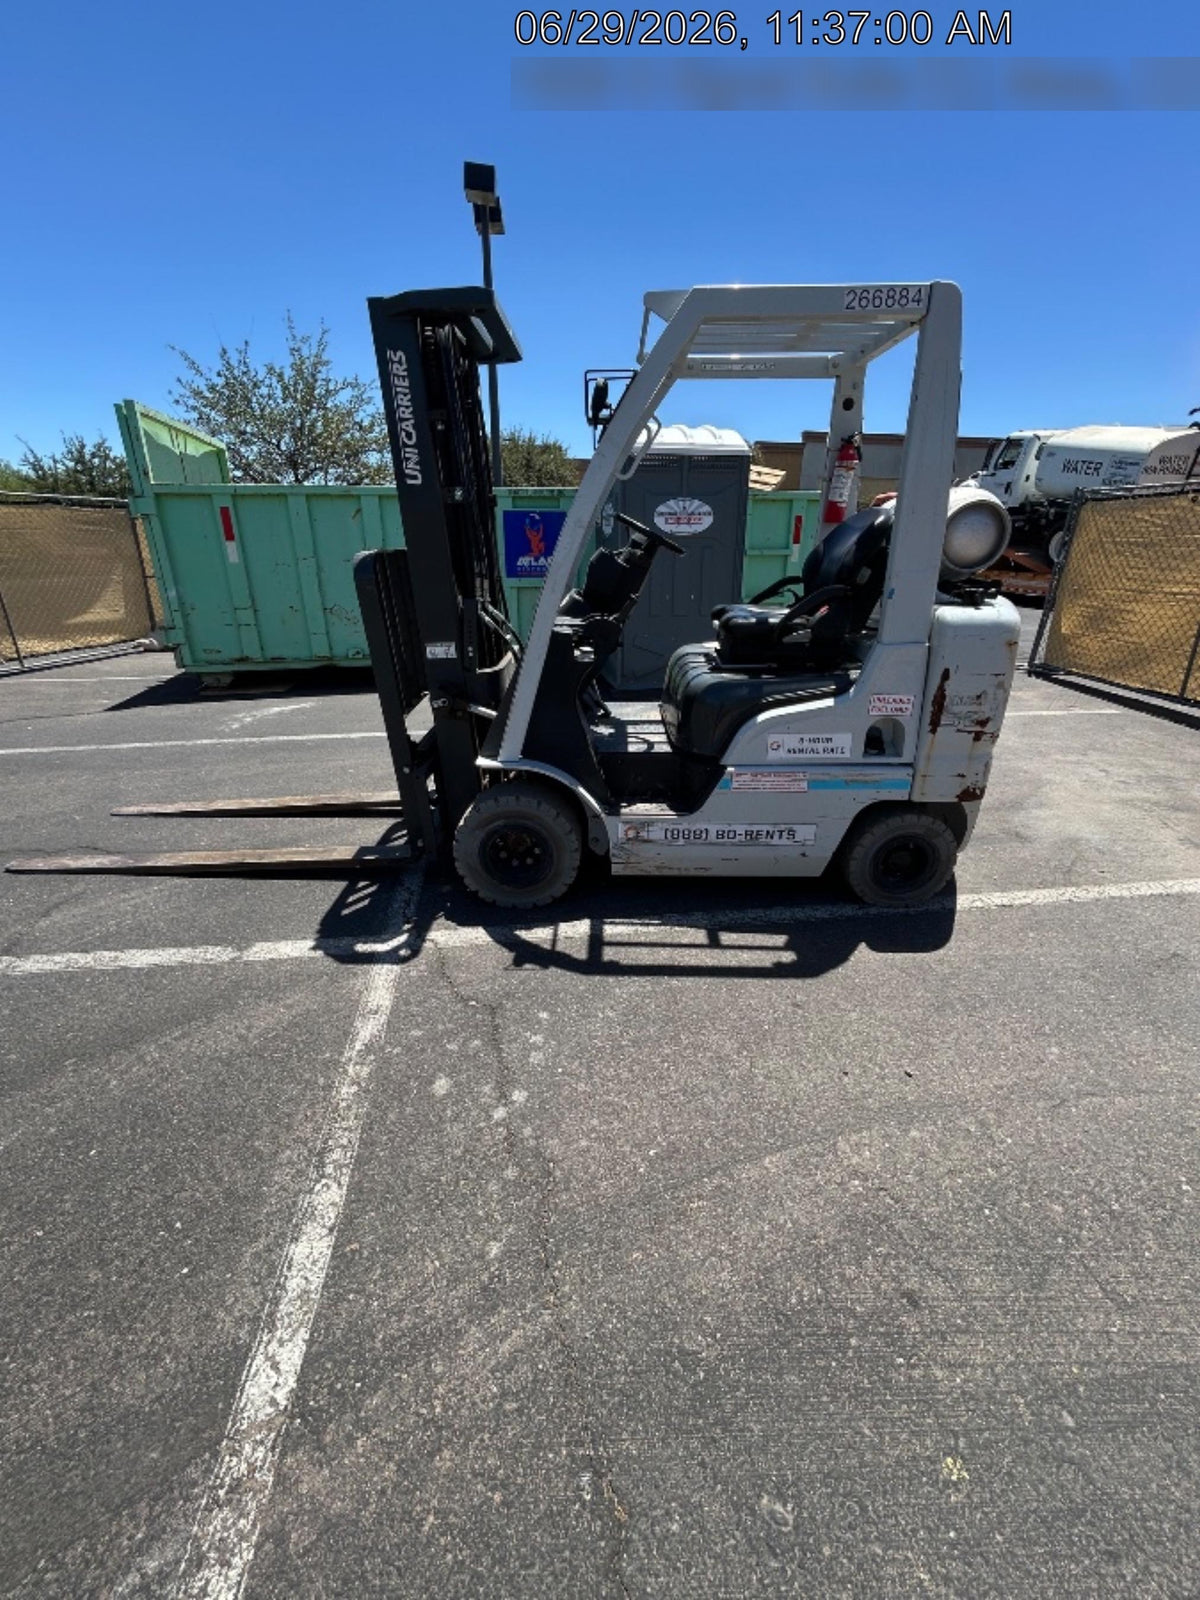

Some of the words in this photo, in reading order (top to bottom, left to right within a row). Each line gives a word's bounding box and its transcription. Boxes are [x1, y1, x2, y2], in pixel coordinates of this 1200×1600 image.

[845, 287, 923, 310] 266884
[387, 349, 422, 485] UNICARRIERS
[1061, 458, 1103, 476] WATER
[664, 827, 709, 842] (888)
